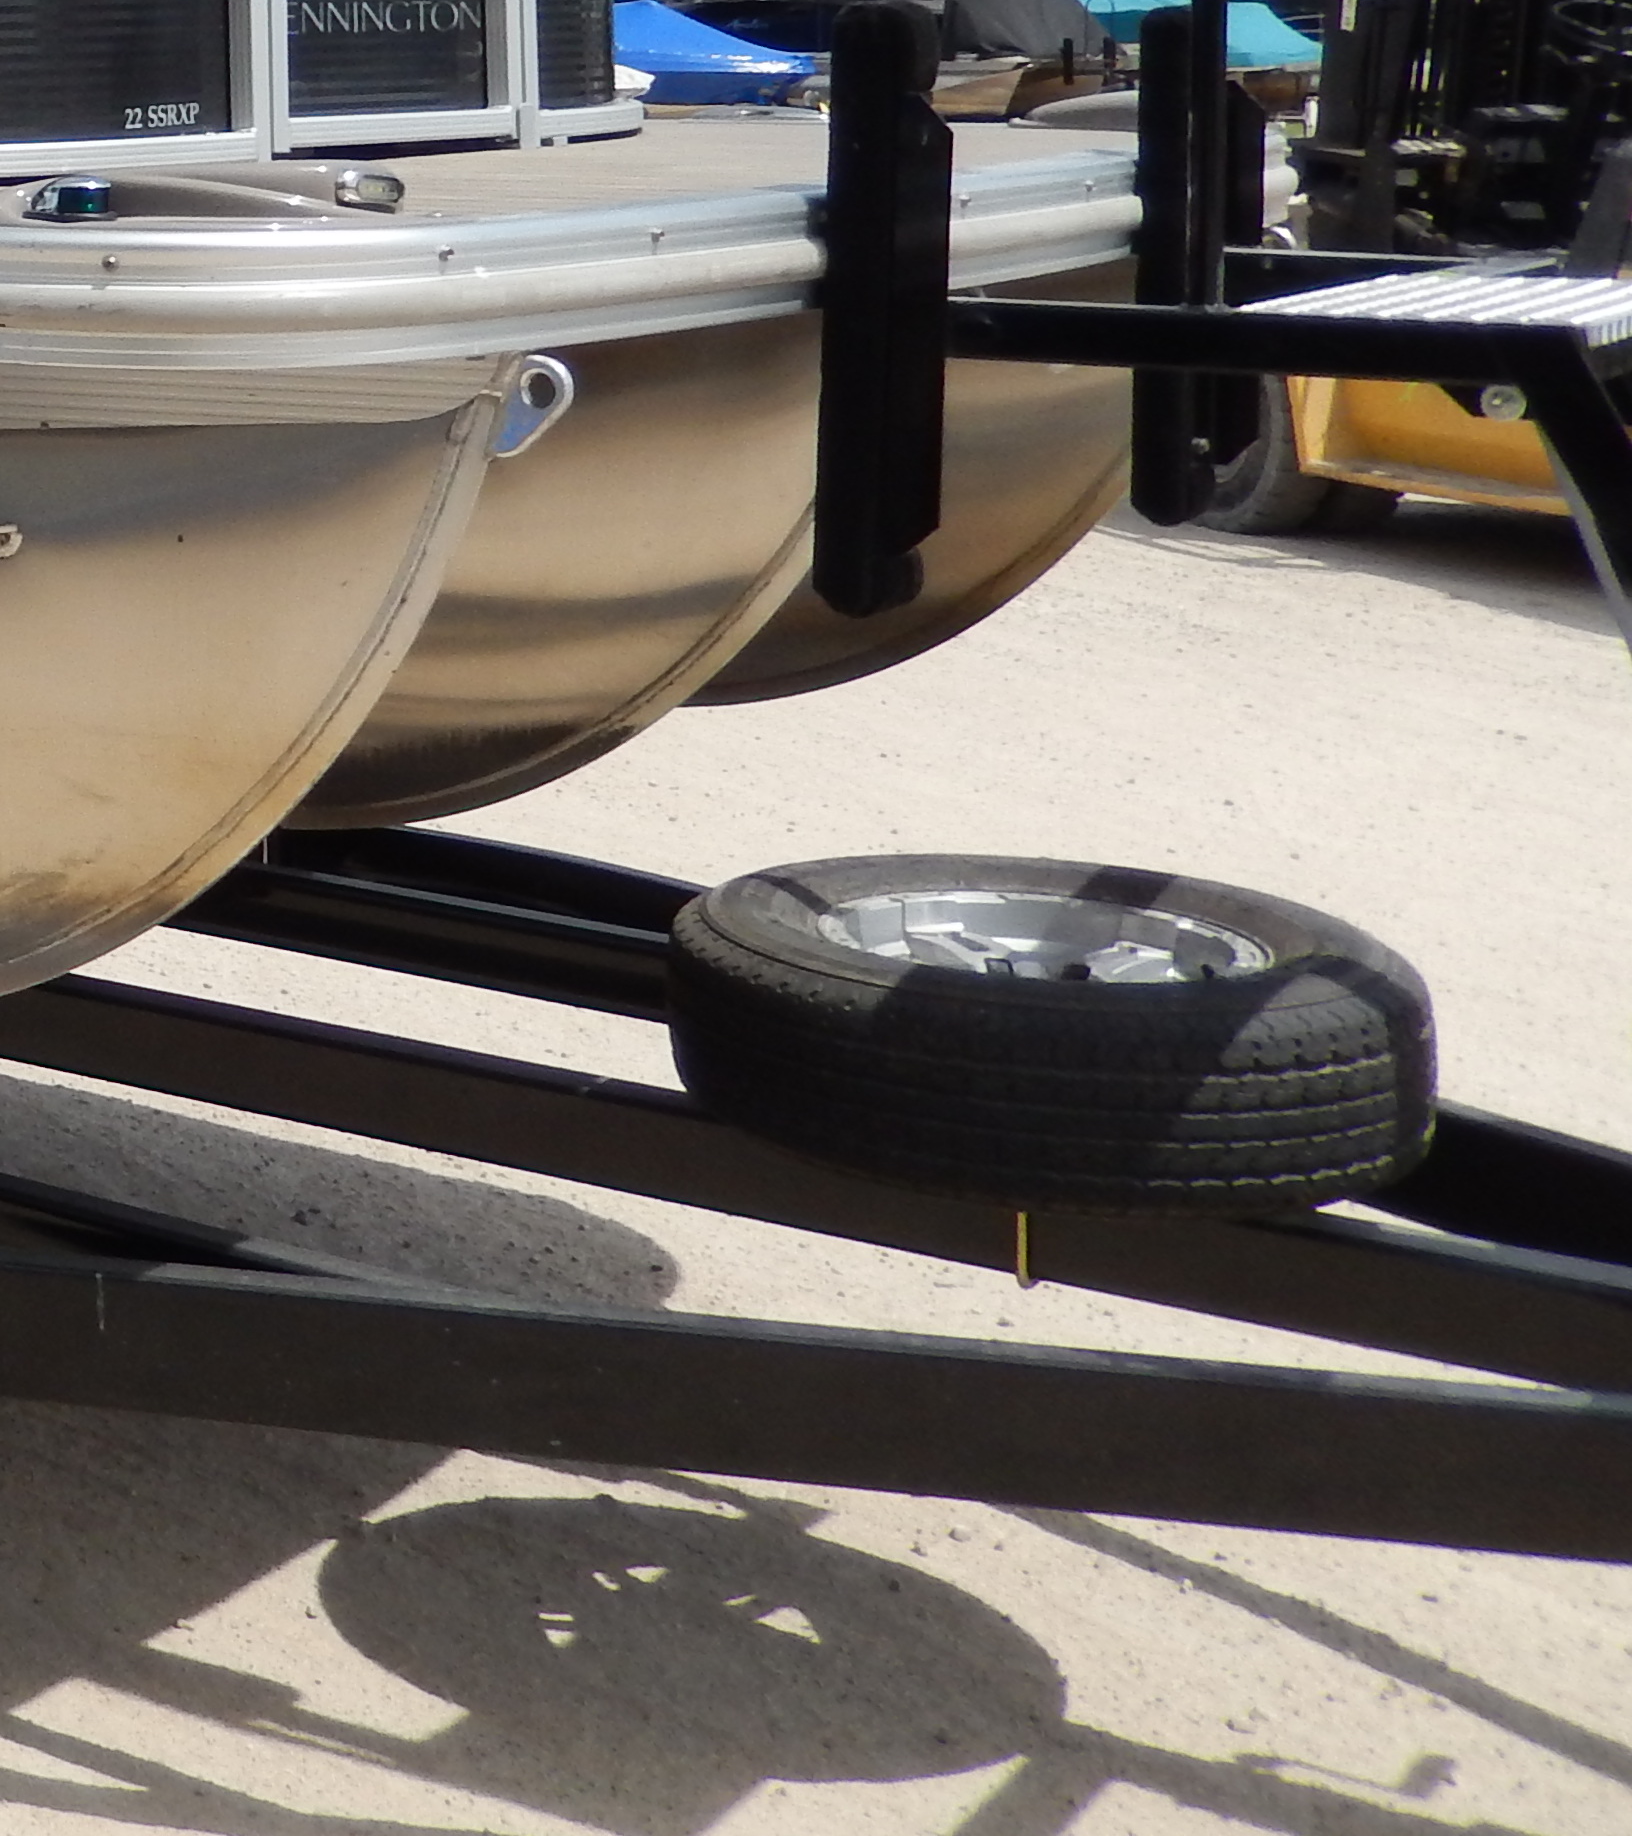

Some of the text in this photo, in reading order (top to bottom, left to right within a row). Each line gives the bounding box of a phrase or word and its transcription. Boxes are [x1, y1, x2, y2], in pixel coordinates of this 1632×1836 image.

[287, 0, 481, 35] ENNINGTON
[124, 102, 200, 129] 22 SSRXP
